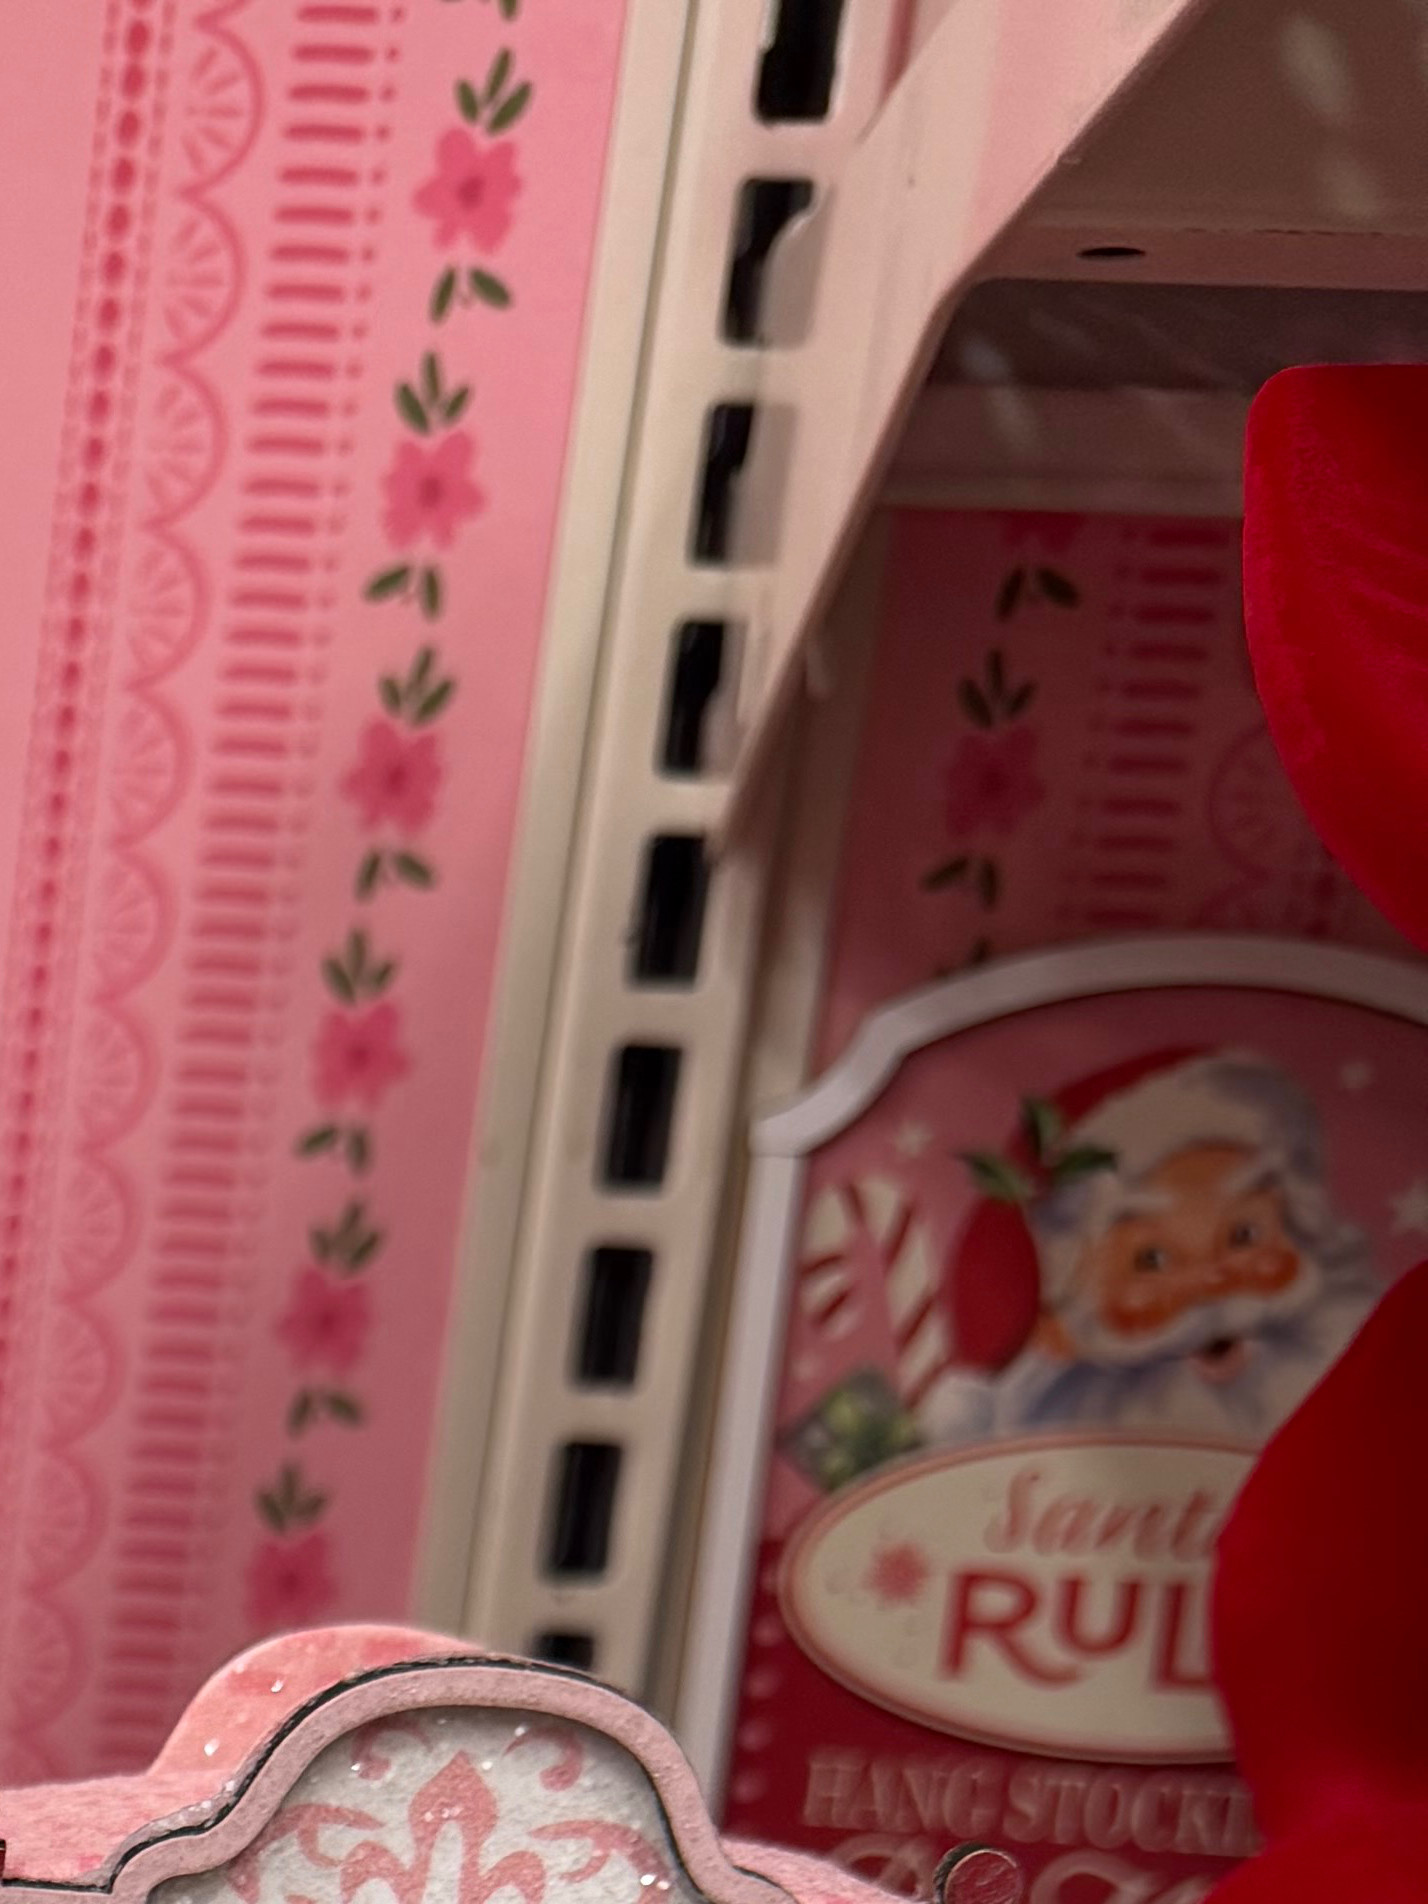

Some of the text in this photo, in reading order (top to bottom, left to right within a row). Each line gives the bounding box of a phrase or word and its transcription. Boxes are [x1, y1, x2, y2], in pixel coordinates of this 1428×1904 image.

[986, 1470, 1218, 1559] Sant
[939, 1565, 1212, 1692] RUL
[803, 1748, 1001, 1840] HANG
